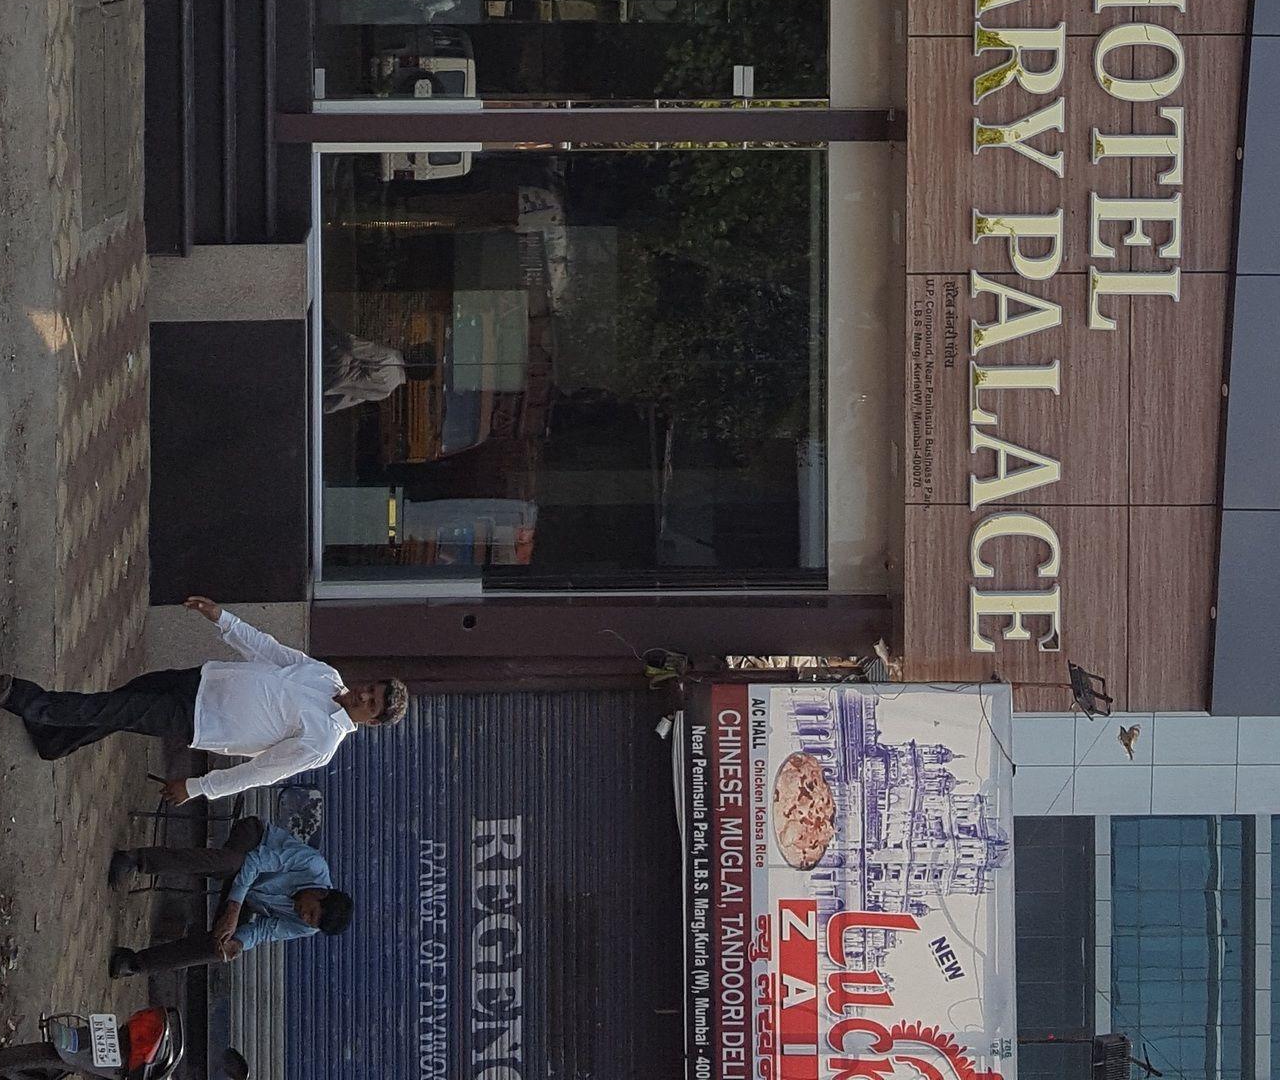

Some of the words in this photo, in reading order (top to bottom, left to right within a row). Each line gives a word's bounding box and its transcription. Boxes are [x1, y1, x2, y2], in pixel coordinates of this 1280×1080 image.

[924, 300, 935, 359] Compound,
[925, 361, 934, 385] Near
[923, 386, 934, 436] Peninsula
[968, 207, 1064, 654] PALACE
[923, 438, 934, 484] Business
[751, 697, 766, 717] A/C
[691, 725, 707, 756] Near
[752, 720, 766, 750] HALL
[715, 709, 743, 813] CHINESE,
[754, 759, 766, 803] Chicken
[692, 758, 708, 819] Peninsula
[690, 822, 709, 855] Park,
[754, 806, 767, 841] Kabsa
[693, 858, 709, 894] L.B.S.
[716, 817, 744, 908] MUGLAI,
[755, 843, 767, 868] Rice
[419, 838, 447, 934] RANGE
[419, 939, 447, 983] OF
[720, 913, 745, 1026] TANDOORI
[930, 935, 966, 981] NEW
[691, 969, 710, 994] (W),
[694, 997, 710, 1046] Mumbai
[108, 1042, 117, 1053] 02
[1004, 1038, 1012, 1059] 786
